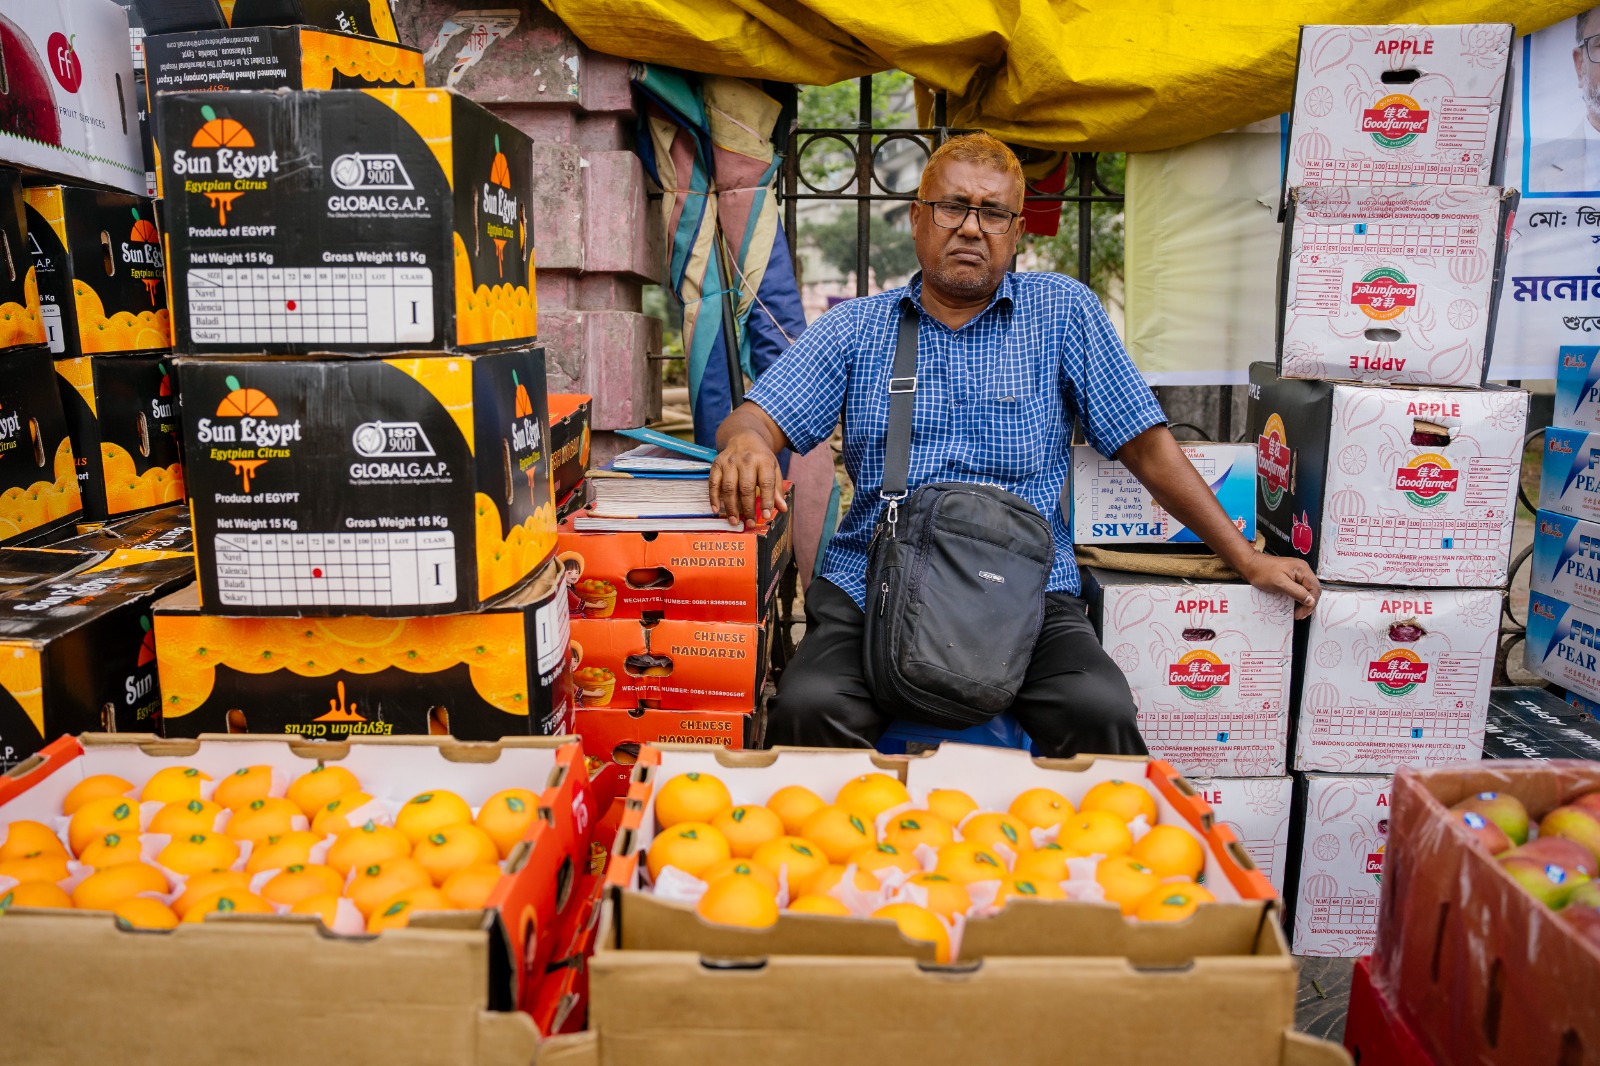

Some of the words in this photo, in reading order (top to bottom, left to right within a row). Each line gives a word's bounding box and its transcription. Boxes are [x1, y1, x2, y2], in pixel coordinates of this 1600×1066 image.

[182, 50, 195, 58] Egypt
[1375, 40, 1434, 55] APPLE
[160, 63, 178, 71] Hospital
[178, 59, 207, 70] International
[156, 75, 173, 85] Export
[174, 75, 182, 84] For
[182, 73, 207, 83] Company
[236, 70, 255, 80] Ahmed
[258, 69, 287, 78] Mohamed
[59, 106, 77, 119] FRUIT
[79, 112, 106, 129] SERVICES
[1383, 107, 1409, 119] 佳农
[1363, 117, 1428, 131] Goodfarmer
[173, 149, 212, 175] Sun
[217, 148, 279, 179] Egypt
[367, 160, 395, 171] ISO
[367, 170, 394, 184] 9001
[184, 180, 231, 193] Egytpian
[234, 179, 267, 190] Citrus
[327, 195, 429, 212] GLOBALG.A.P.
[483, 183, 497, 215] Sun
[498, 187, 517, 225] Egypt
[188, 227, 228, 237] Produce
[229, 226, 240, 237] of
[242, 226, 276, 236] EGYPT
[121, 242, 143, 264] Sun
[190, 253, 207, 263] Net
[208, 252, 243, 265] Weight
[245, 252, 258, 262] 15
[259, 252, 274, 264] Kg
[322, 251, 354, 262] Gross
[356, 251, 393, 264] Weight
[395, 251, 408, 262] 16
[410, 251, 426, 265] Kg
[44, 294, 55, 302] Kg
[195, 289, 216, 297] Navel
[1352, 285, 1416, 299] Goodfarmer
[191, 302, 222, 311] Valencia
[411, 301, 419, 324] I
[196, 317, 219, 325] Baladi
[195, 331, 220, 340] Sokary
[1349, 355, 1406, 371] APPLE
[152, 398, 172, 419] Sun
[1406, 401, 1461, 417] APPLE
[198, 417, 236, 443] Sun
[240, 417, 302, 447] Egypt
[388, 428, 416, 438] ISO
[512, 422, 526, 452] Sun
[389, 437, 416, 451] 9001
[210, 448, 255, 460] Egytpian
[257, 447, 291, 458] Citrus
[349, 462, 450, 478] GLOBALG.A.P.
[1258, 449, 1289, 484] Goodfarmer
[1417, 467, 1440, 478] 佳农
[1397, 475, 1458, 490] Goodfarmer
[1120, 486, 1142, 494] Century
[215, 493, 252, 503] Produce
[254, 492, 264, 503] of
[265, 492, 300, 503] EGYPT
[217, 518, 233, 528] Net
[234, 518, 267, 531] Weight
[269, 518, 281, 528] 15
[283, 518, 298, 530] Kg
[345, 517, 377, 528] Gross
[378, 516, 416, 529] Weight
[417, 516, 431, 527] 16
[432, 515, 448, 528] Kg
[1092, 522, 1163, 537] PEARS
[692, 541, 745, 551] CHINESE
[223, 553, 242, 561] Navel
[1337, 550, 1373, 558] SHANDONG
[1373, 552, 1418, 560] GOODFARMER
[670, 557, 745, 567] MANDARIN
[219, 566, 247, 575] Valencia
[434, 563, 441, 586] I
[224, 580, 245, 588] Baladi
[224, 593, 247, 603] Sokary
[623, 596, 663, 604] WECHAT/TEL
[1174, 599, 1229, 613] APPLE
[1380, 600, 1433, 615] APPLE
[694, 631, 746, 643] CHINESE
[671, 645, 746, 659] MANDARIN
[1557, 642, 1597, 672] PEAR
[1188, 661, 1212, 673] 佳农
[1387, 659, 1411, 670] 佳农
[1169, 671, 1230, 684] Goodfarmer
[1368, 668, 1427, 681] Goodfarmer
[126, 674, 152, 705] Sun
[662, 686, 690, 694] NUMBER:
[1514, 700, 1567, 726] APPLE
[284, 723, 327, 737] Citrus
[331, 721, 393, 736] Egytpian
[679, 720, 732, 731] CHINESE
[658, 734, 732, 746] MANDARIN
